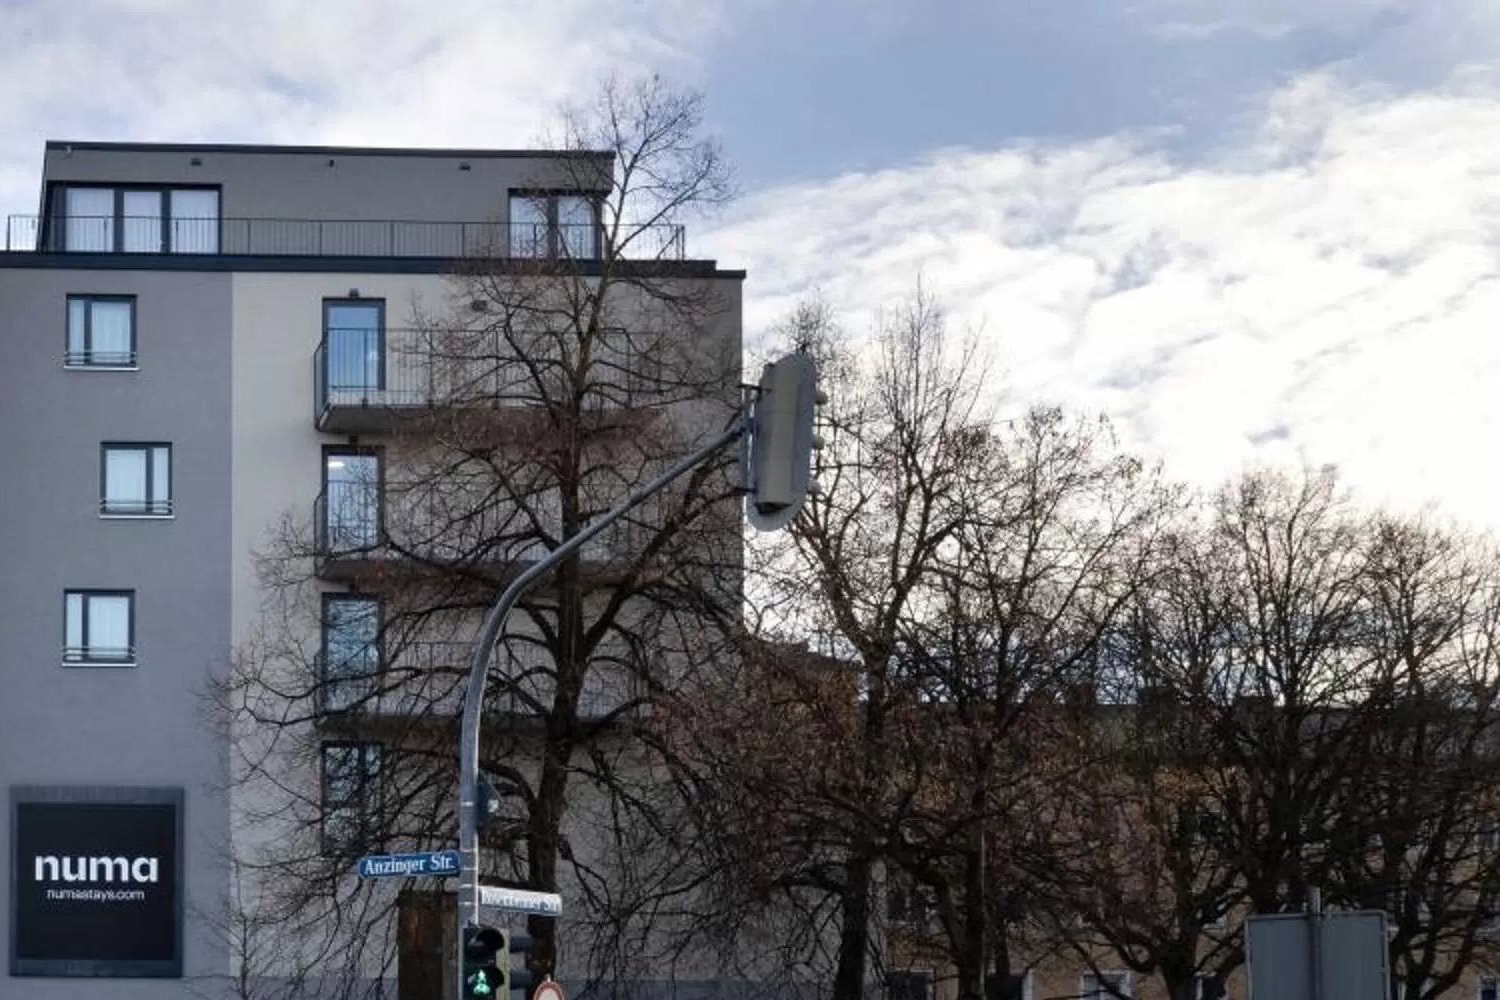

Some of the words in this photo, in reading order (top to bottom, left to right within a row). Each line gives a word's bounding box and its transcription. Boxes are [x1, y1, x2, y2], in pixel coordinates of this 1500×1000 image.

[34, 854, 159, 883] numa
[364, 857, 426, 875] Anzinger
[430, 855, 455, 871] Str.
[47, 888, 145, 903] numastays.com
